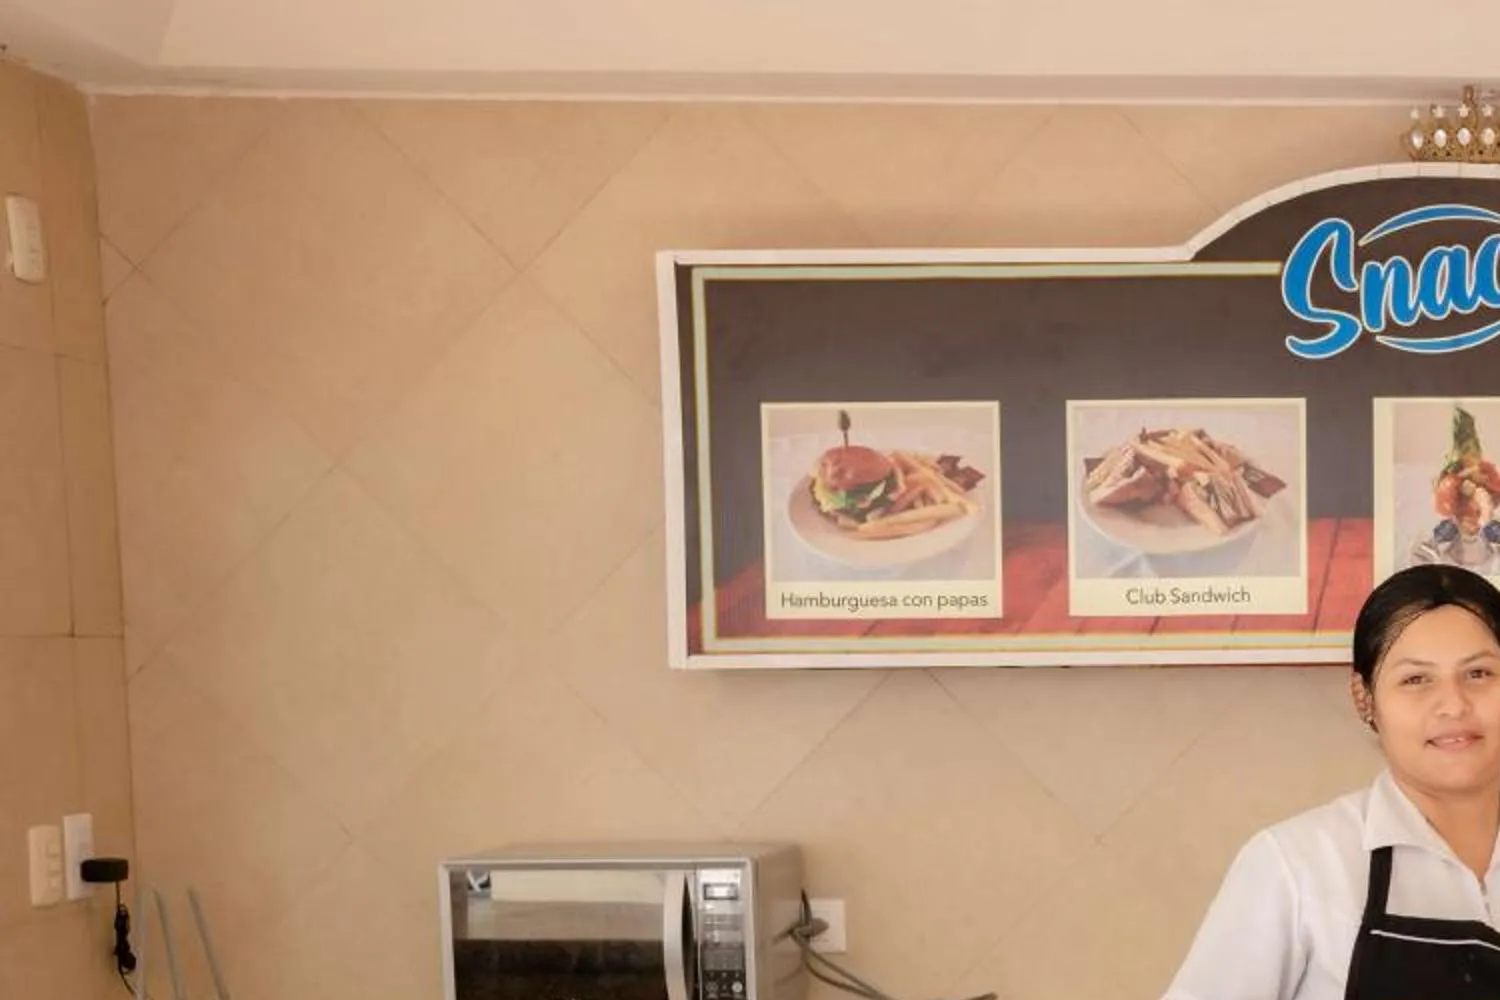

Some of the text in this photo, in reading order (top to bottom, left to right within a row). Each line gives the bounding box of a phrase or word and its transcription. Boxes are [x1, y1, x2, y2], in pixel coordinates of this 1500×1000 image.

[780, 592, 989, 613] Hamburguesa con papas
[1125, 584, 1250, 605] Club Sandwich
